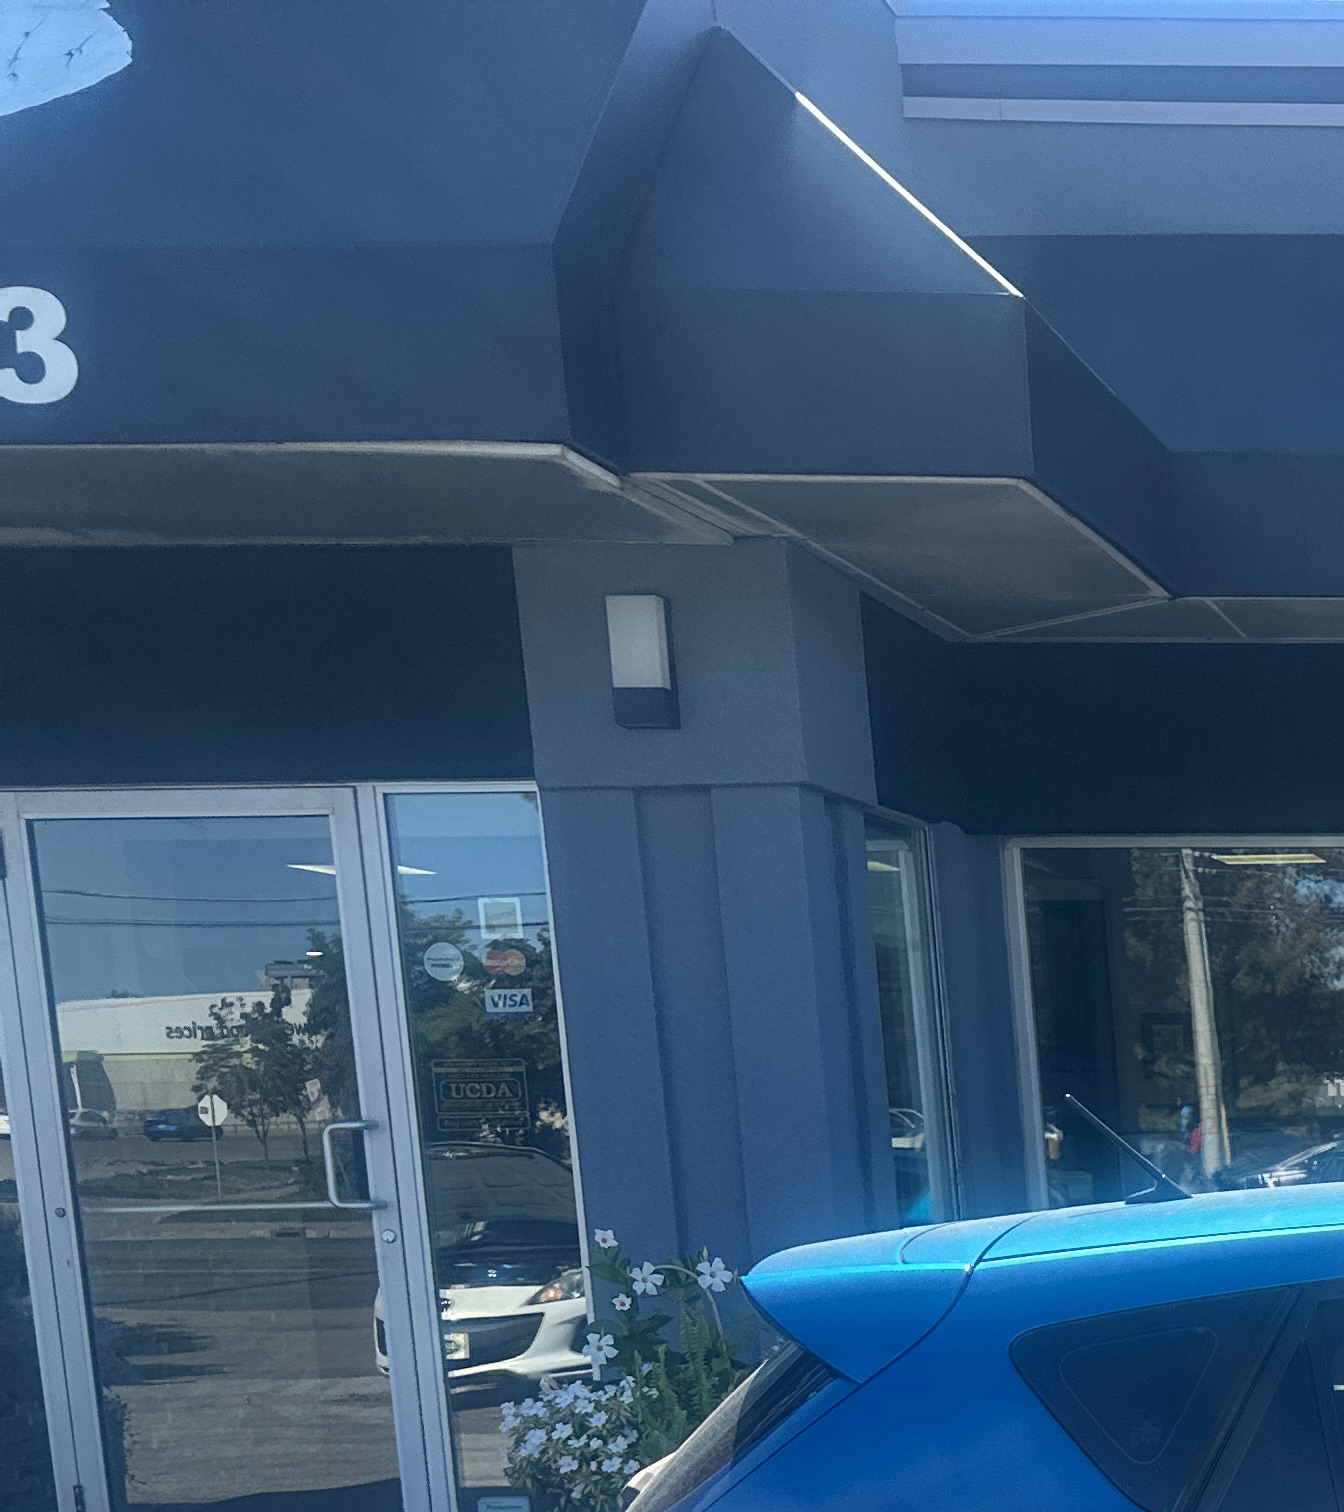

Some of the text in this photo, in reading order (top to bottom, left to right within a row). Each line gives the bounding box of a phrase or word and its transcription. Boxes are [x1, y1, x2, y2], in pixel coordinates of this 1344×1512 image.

[0, 286, 79, 404] 3
[490, 993, 530, 1008] VISA
[449, 1082, 512, 1098] UCDA
